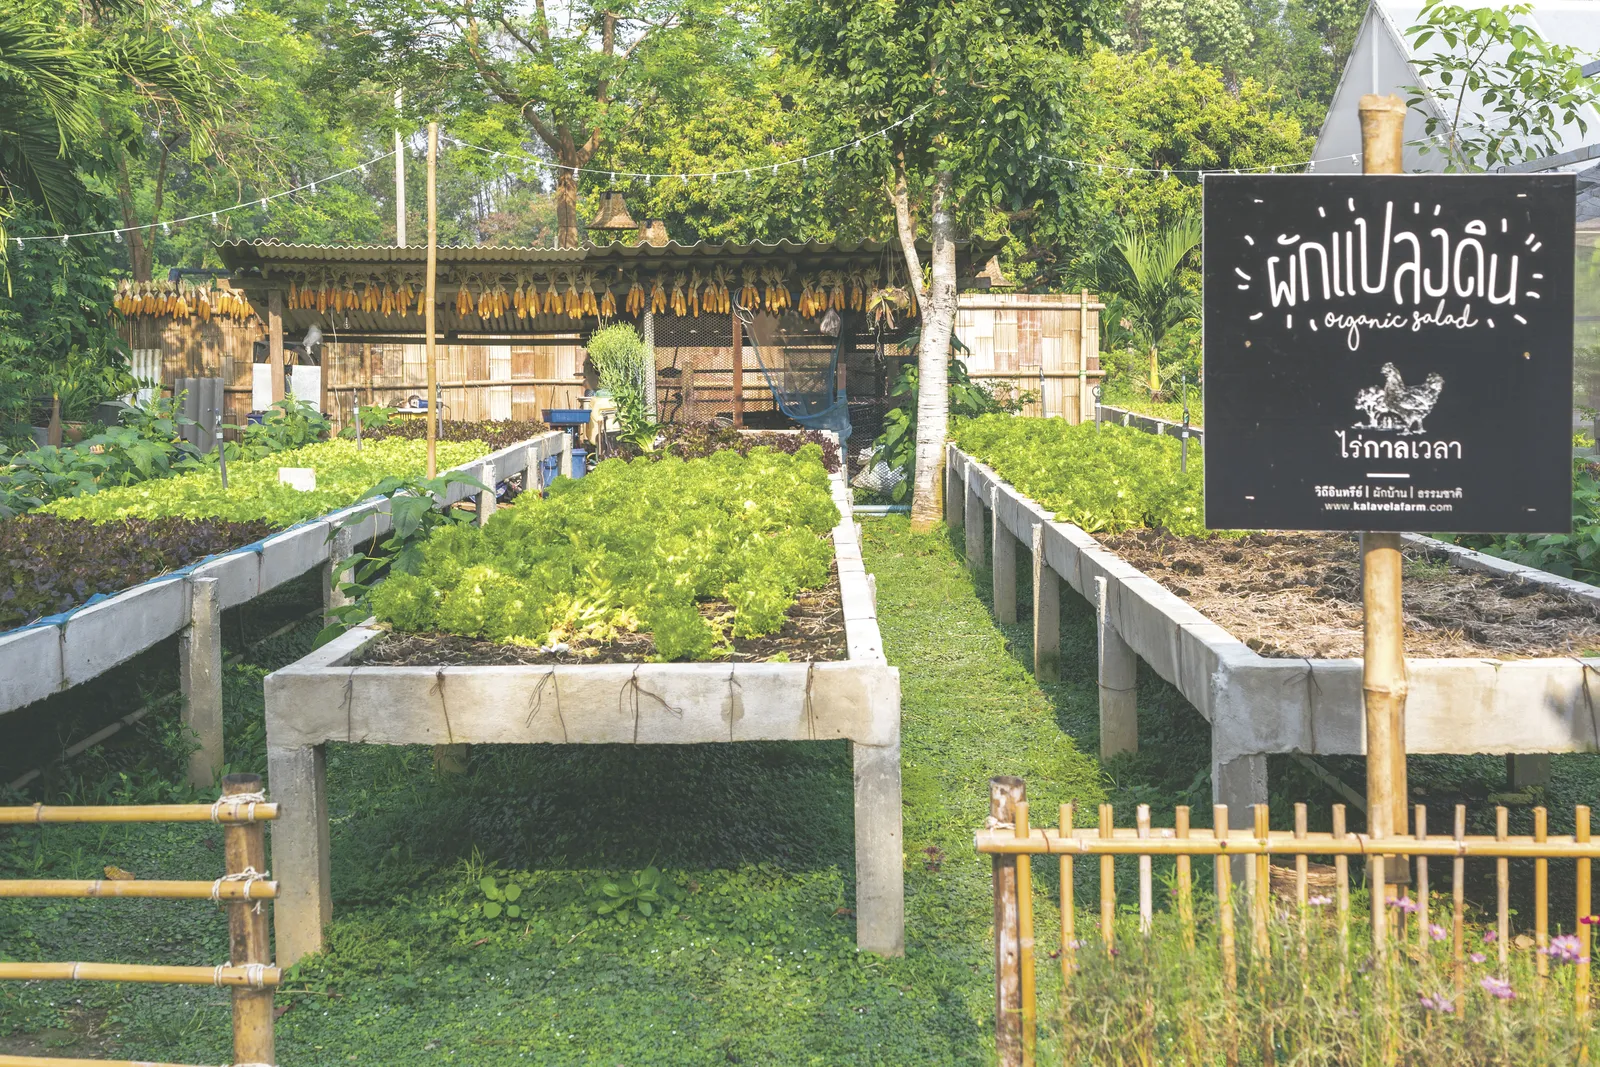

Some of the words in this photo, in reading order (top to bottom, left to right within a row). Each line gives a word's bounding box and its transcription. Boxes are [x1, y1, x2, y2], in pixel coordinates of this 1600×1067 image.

[1267, 200, 1519, 308] ผักแปลงดิน
[1324, 311, 1407, 351] organic
[1412, 299, 1478, 332] salad
[1335, 430, 1462, 459] ไร่กาลเวลา
[1314, 485, 1363, 498] วิถีอินทรีย์
[1373, 486, 1408, 499] ผักบ้าน
[1417, 487, 1463, 499] ธรรมชาติ
[1324, 502, 1453, 512] www.kalavelafarm.com
